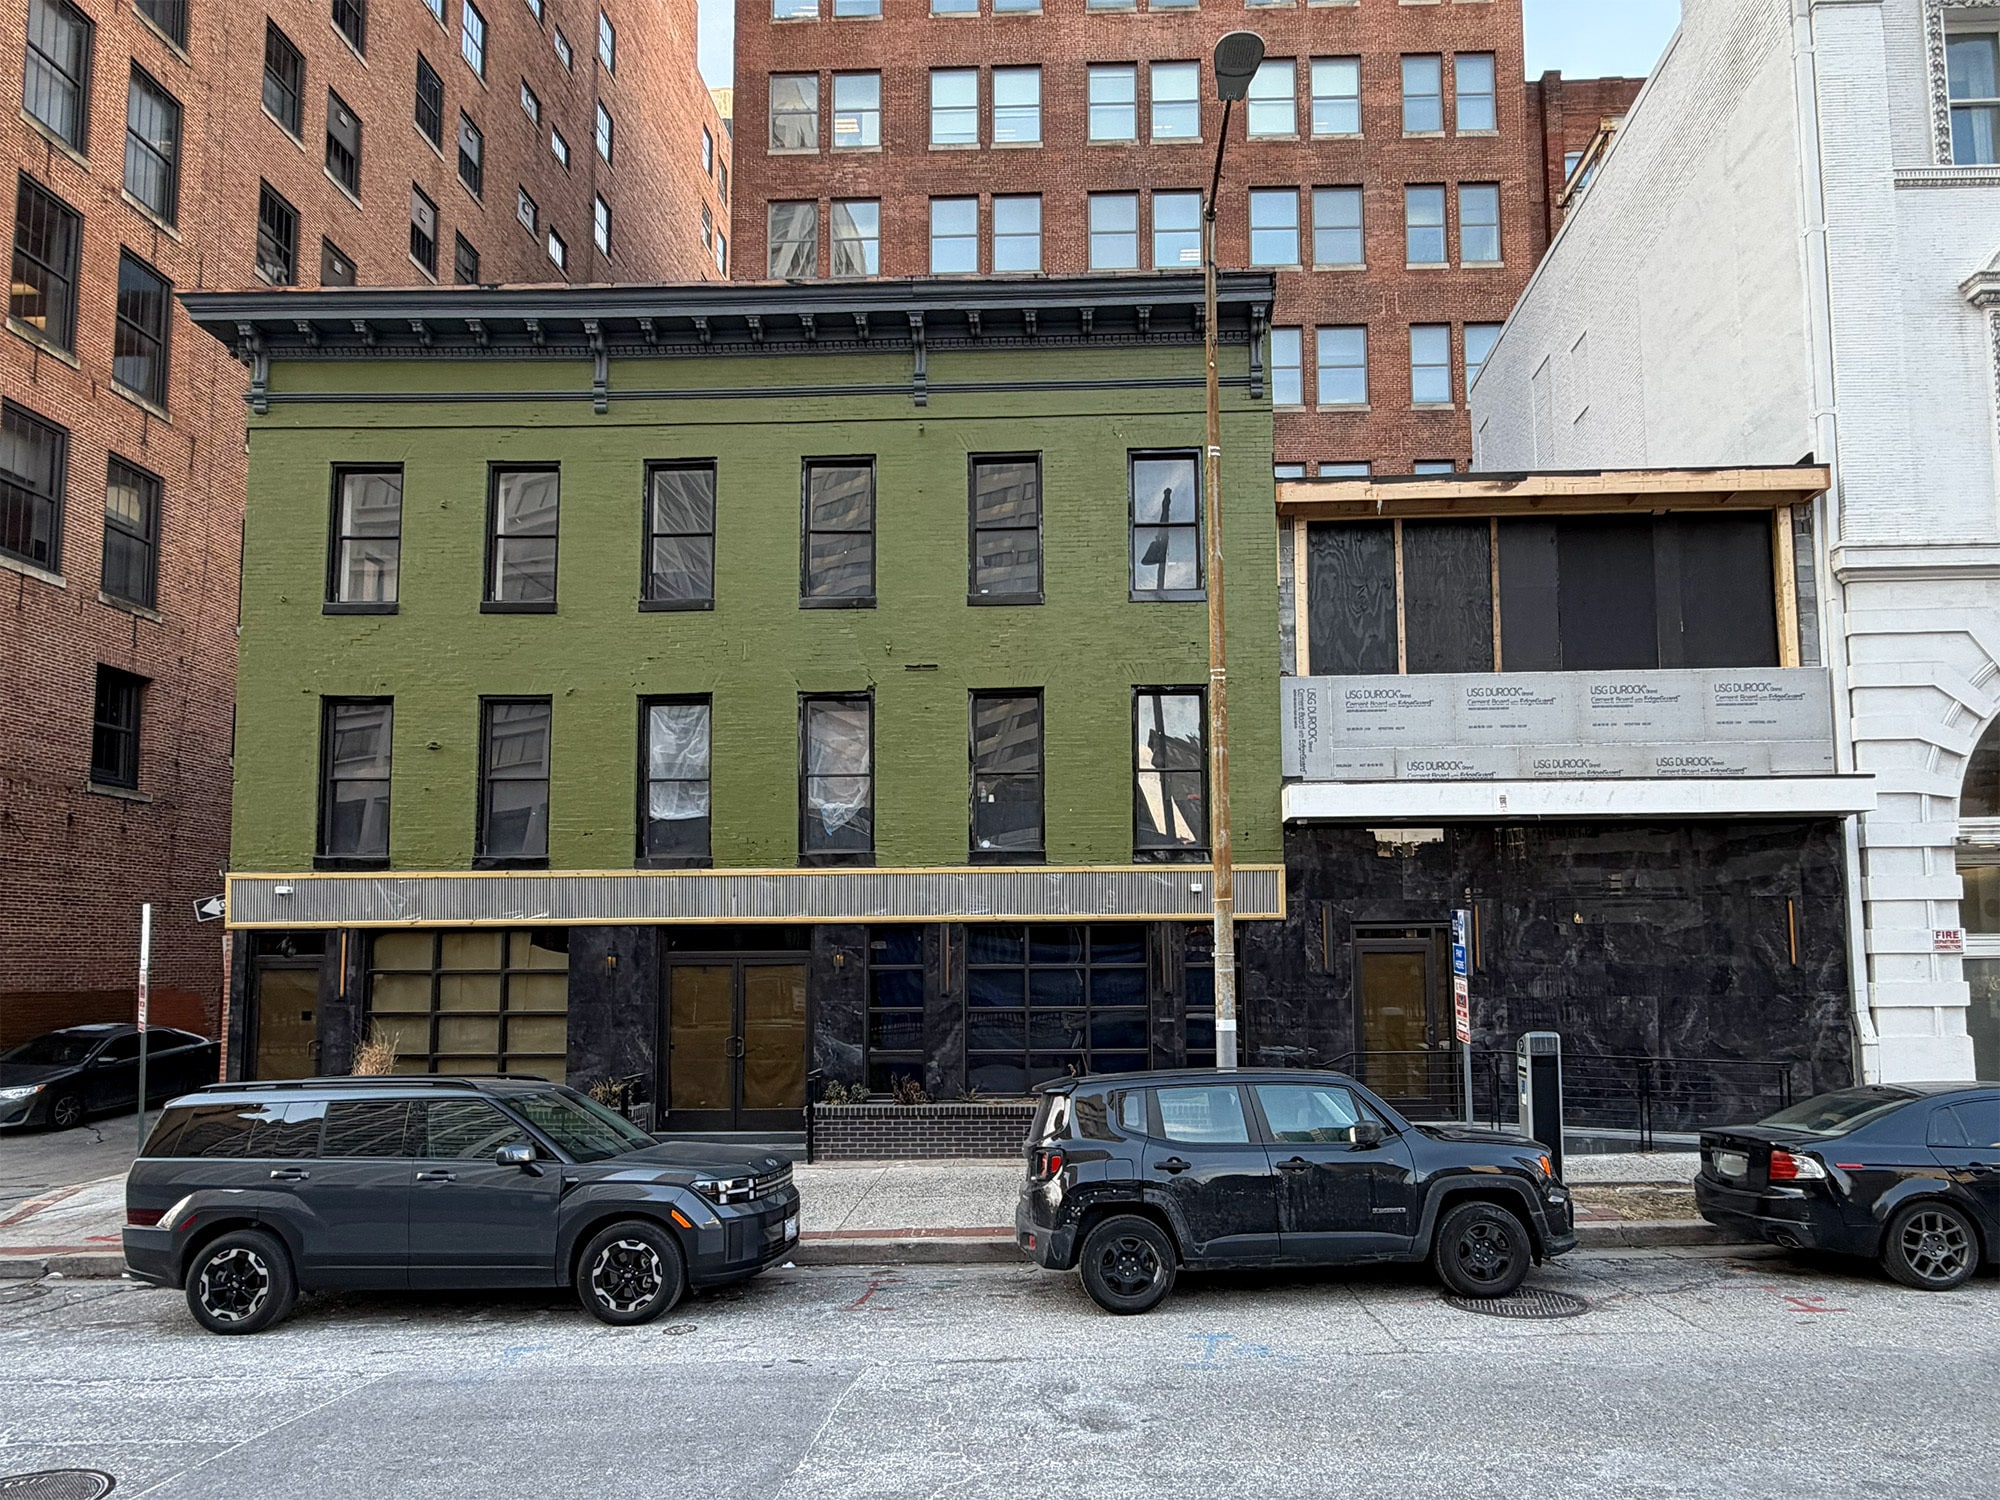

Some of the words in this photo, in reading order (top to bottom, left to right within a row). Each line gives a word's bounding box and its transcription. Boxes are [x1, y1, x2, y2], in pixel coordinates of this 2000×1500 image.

[1467, 688, 1484, 697] USG
[1485, 687, 1522, 696] DUROCK
[1590, 685, 1608, 695] USG
[1609, 685, 1646, 694] DUROCK
[1714, 683, 1732, 693] USG
[1733, 682, 1770, 692] DUROCK
[1307, 688, 1316, 705] USG
[1345, 690, 1362, 699] USG
[1364, 690, 1400, 699] DUROCK
[1307, 706, 1317, 742] DUROCK
[1406, 762, 1424, 771] USG
[1425, 761, 1462, 771] DUROCK
[1533, 760, 1550, 769] USG
[1552, 759, 1589, 768] DUROCK
[1656, 757, 1674, 766] USG
[1675, 757, 1712, 766] DUROCK
[1936, 930, 1960, 939] FIRE
